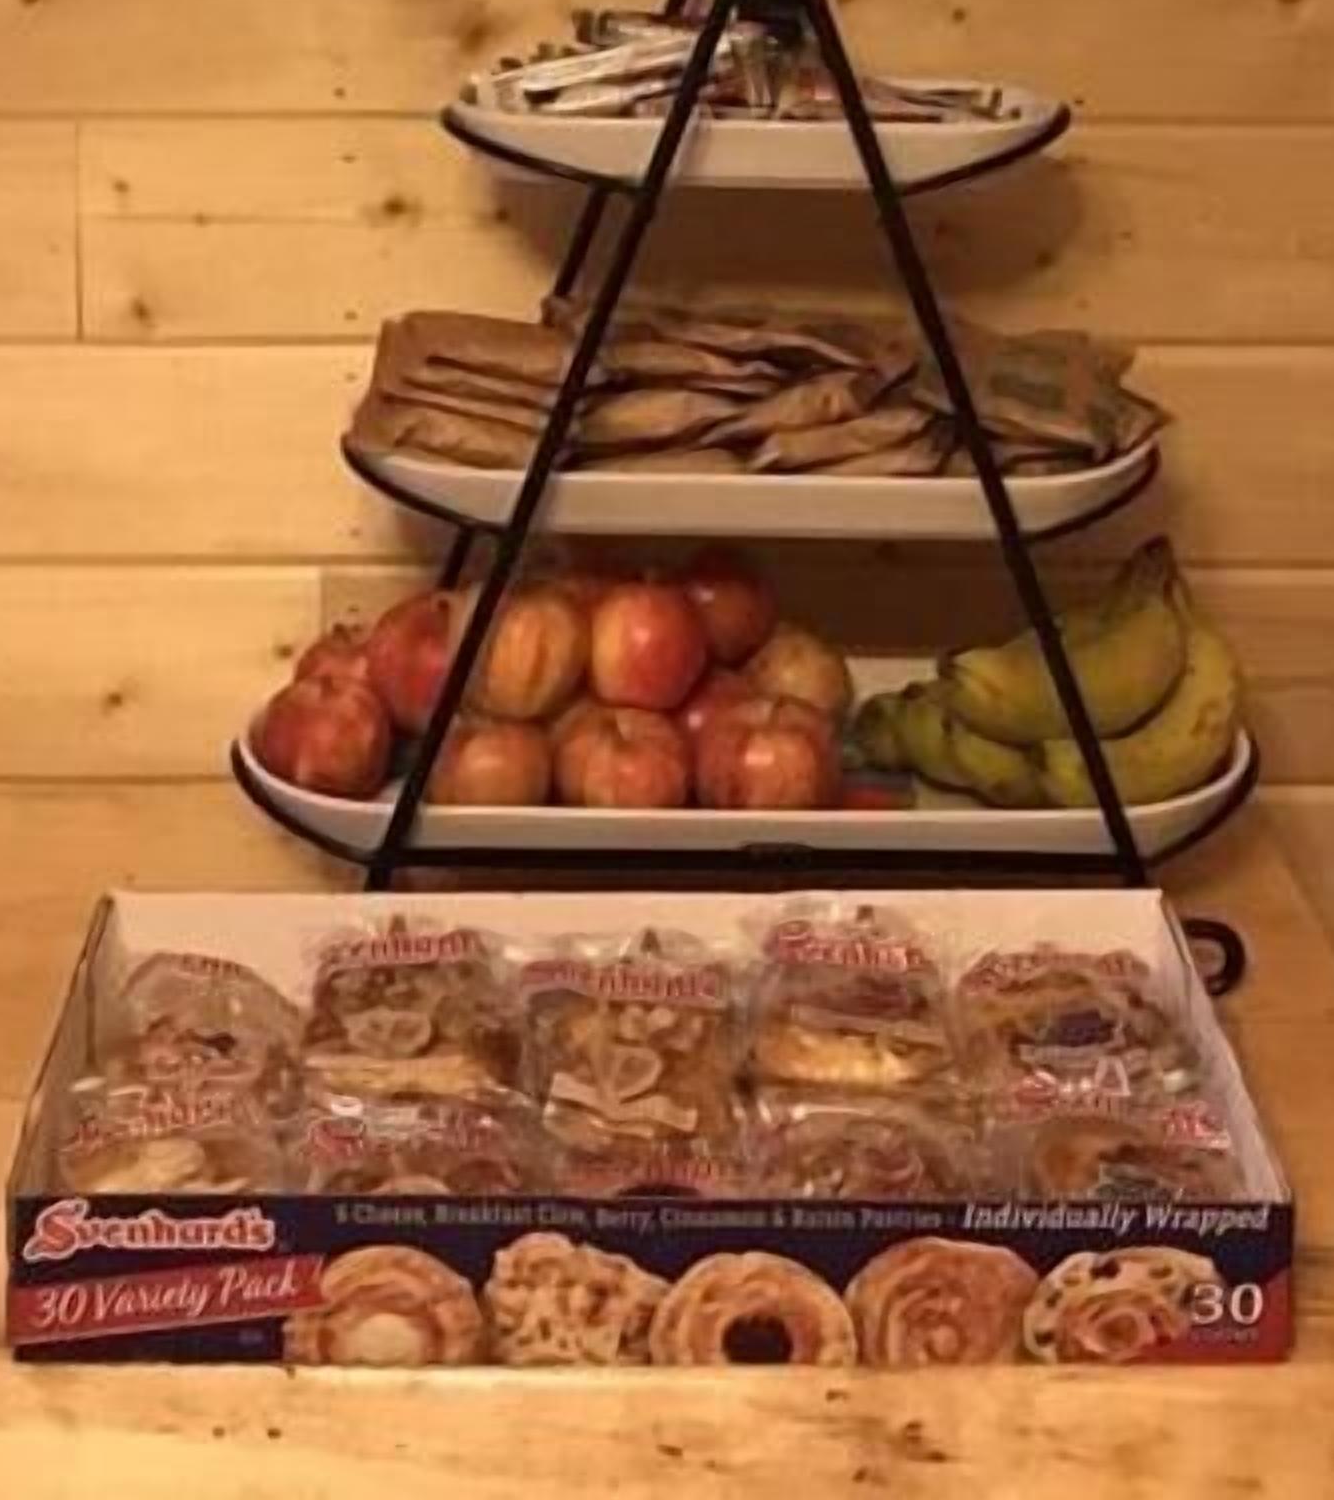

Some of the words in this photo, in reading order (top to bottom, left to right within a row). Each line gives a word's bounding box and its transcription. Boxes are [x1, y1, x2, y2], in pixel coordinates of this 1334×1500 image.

[23, 1198, 275, 1262] Svenhard's
[963, 1202, 1138, 1235] Individually
[1144, 1202, 1269, 1236] Wrapped
[31, 1284, 87, 1329] 30
[94, 1277, 209, 1321] Variety
[219, 1258, 297, 1306] Pack
[1190, 1283, 1264, 1326] 30
